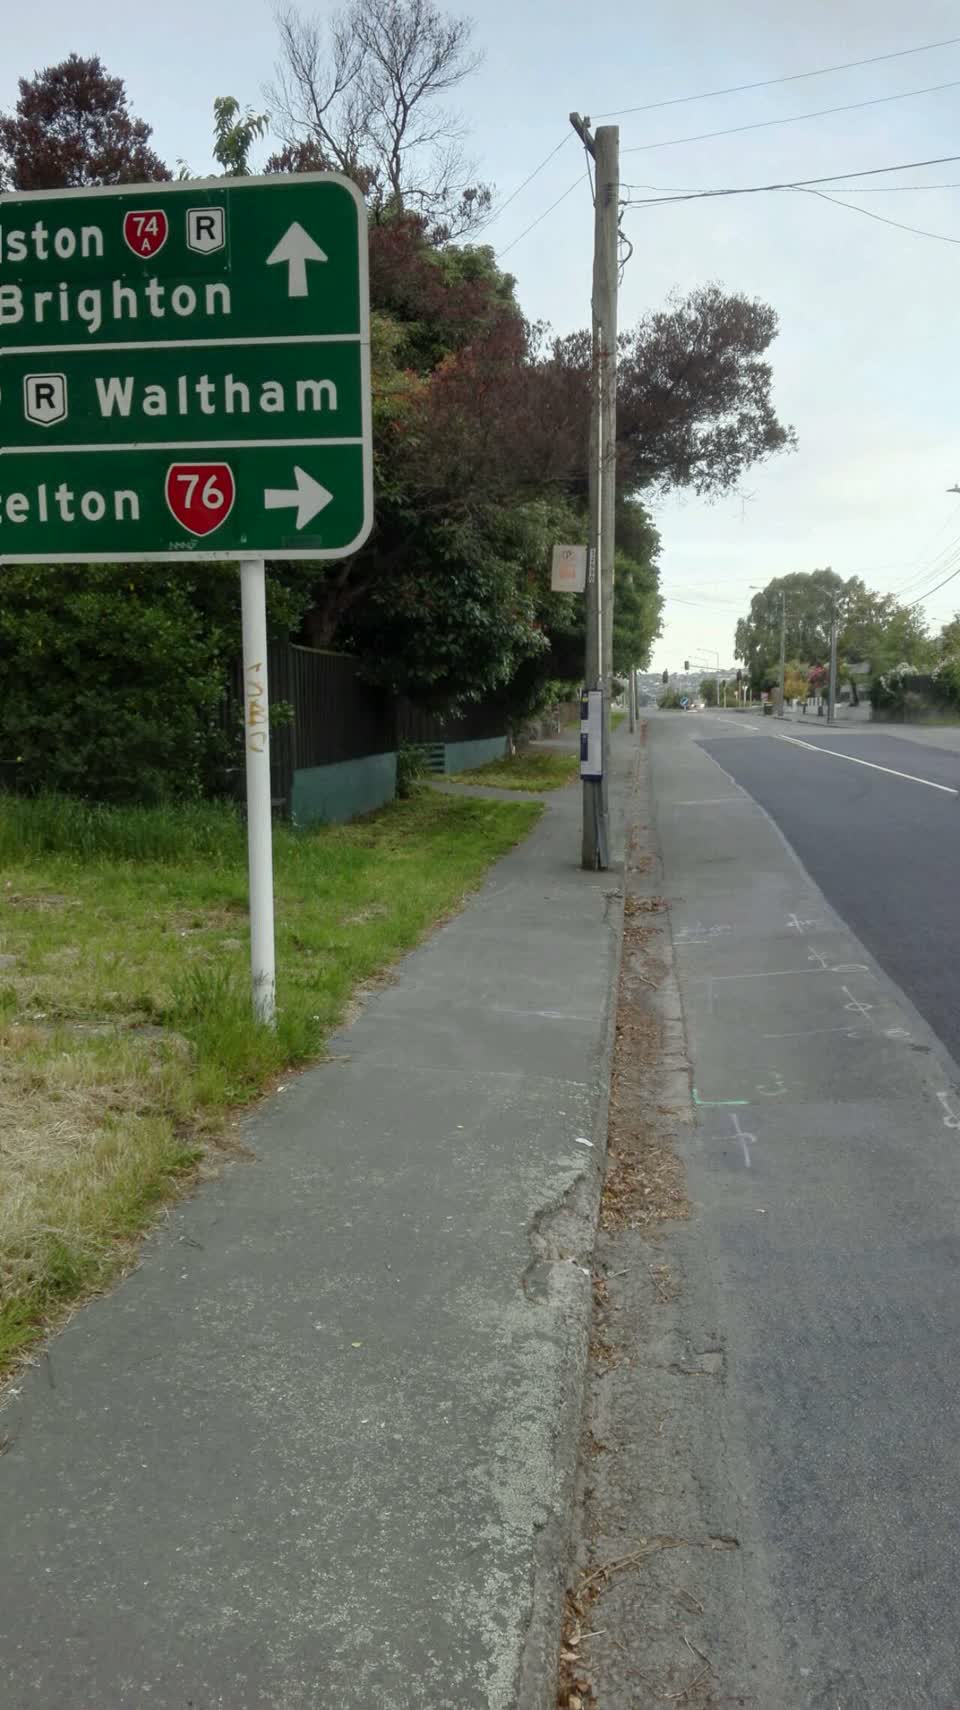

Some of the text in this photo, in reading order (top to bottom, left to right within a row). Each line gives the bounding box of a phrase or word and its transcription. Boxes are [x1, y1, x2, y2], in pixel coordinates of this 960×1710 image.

[0, 215, 216, 264] ston 74 R
[141, 238, 151, 251] A
[0, 277, 231, 334] Brighton
[35, 373, 337, 417] R Waltham
[0, 474, 225, 523] elton 76
